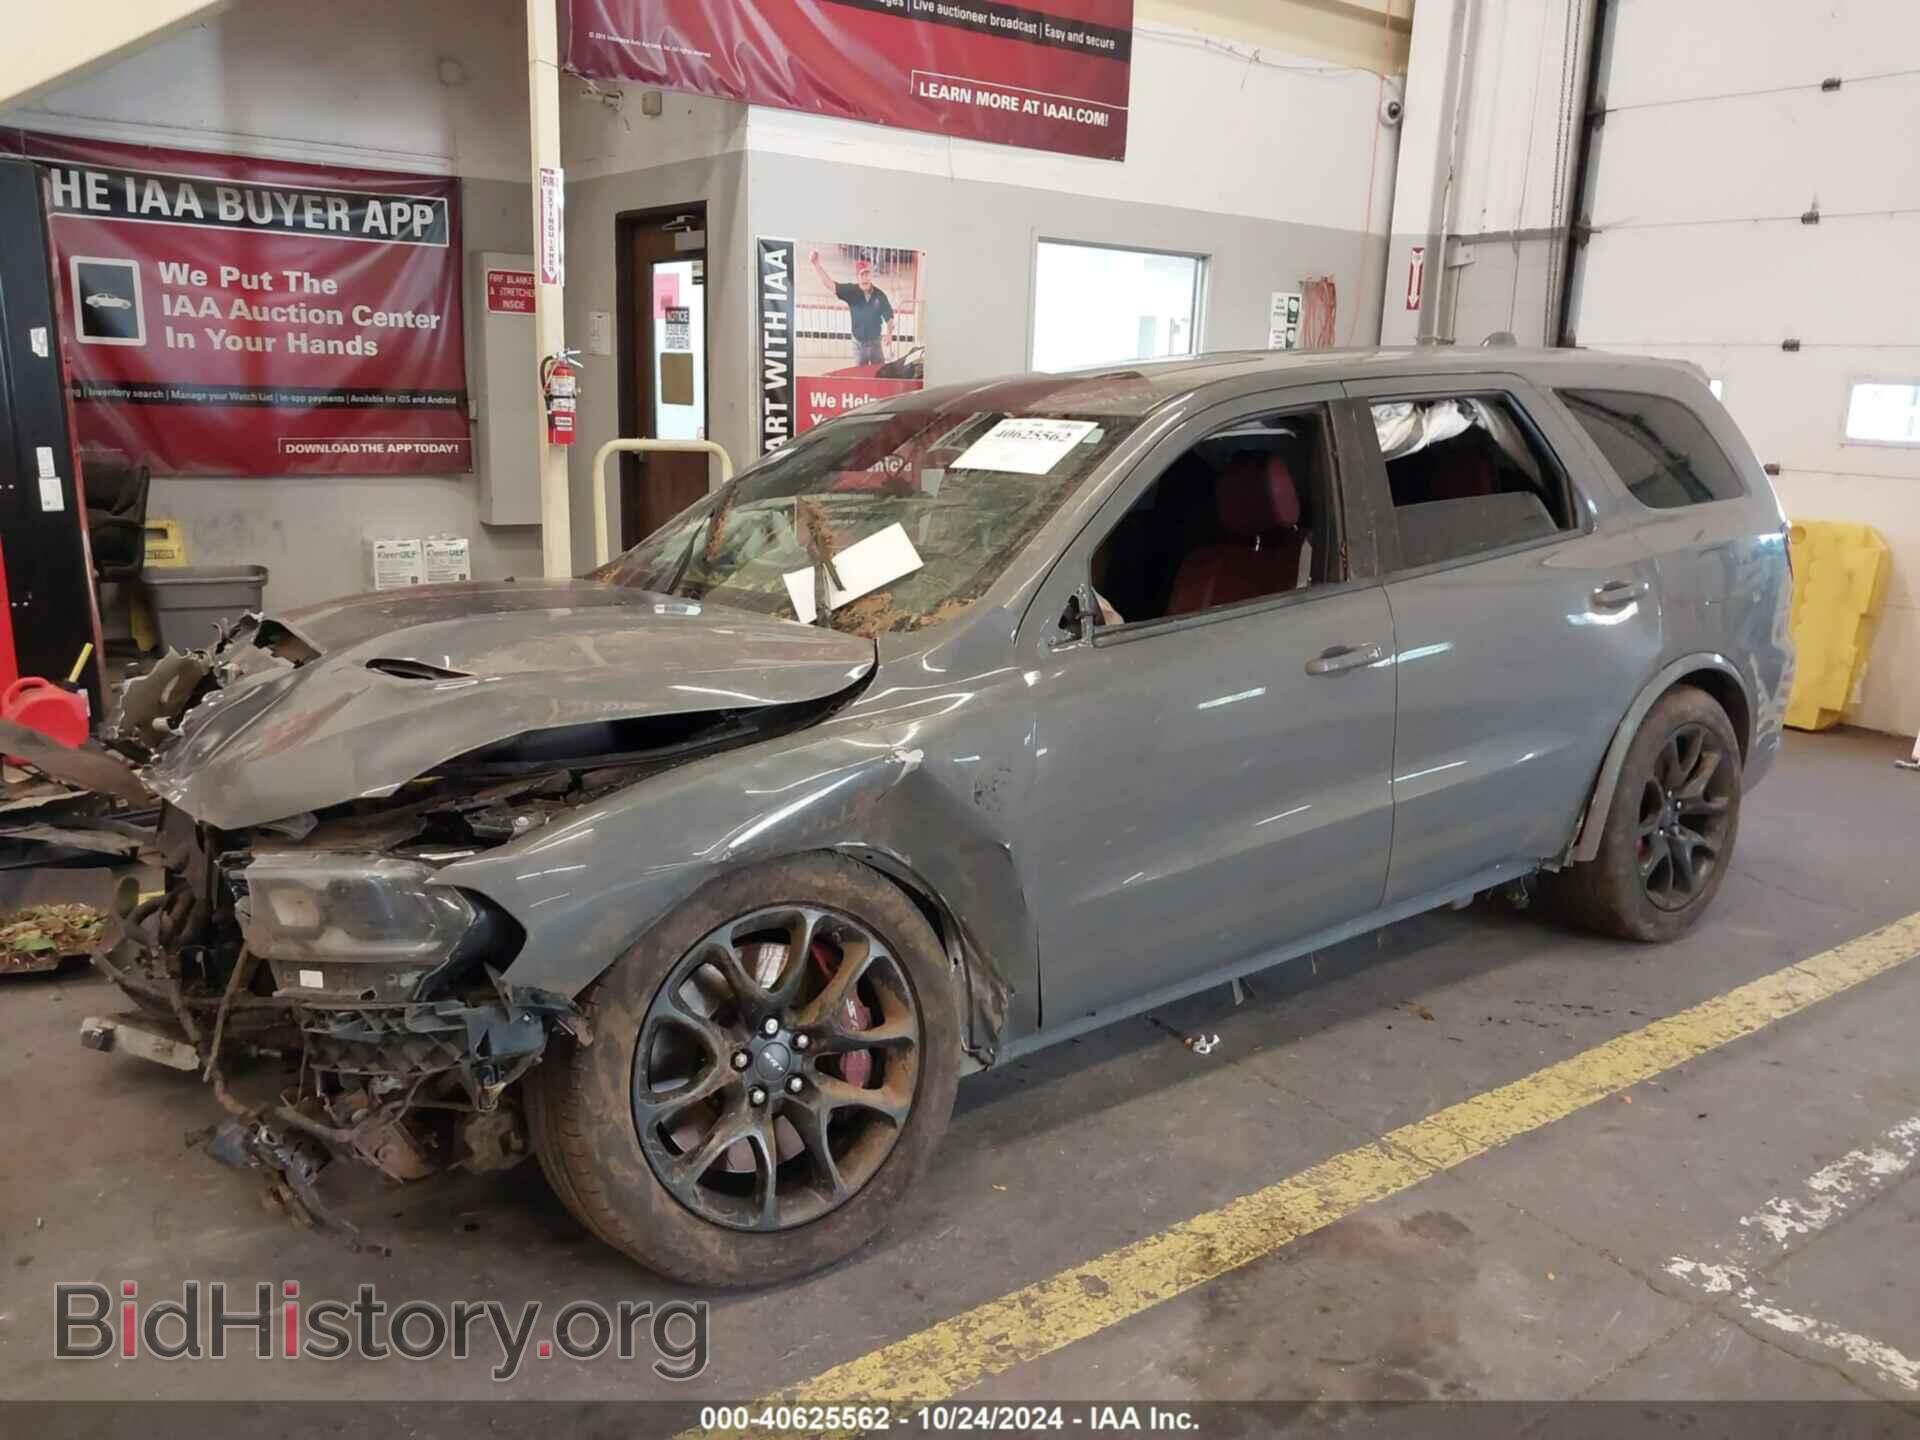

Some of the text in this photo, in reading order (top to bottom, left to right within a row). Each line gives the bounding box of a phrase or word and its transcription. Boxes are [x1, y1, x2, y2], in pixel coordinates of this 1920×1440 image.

[914, 0, 935, 12] Live
[937, 4, 987, 24] auctioneer
[990, 12, 1038, 34] broadcast
[1045, 23, 1065, 41] Easy
[1068, 27, 1084, 44] and
[1086, 34, 1115, 49] secure
[919, 81, 1109, 127] LEARN MORE AT IAAI.COM!
[51, 168, 434, 237] HE IAA BUYER APP
[158, 261, 338, 295] We Put The
[162, 294, 441, 329] IAA Auction Center
[667, 310, 688, 322] NOTICE
[165, 326, 378, 357] In Your Hands
[764, 249, 787, 450] ART WITH IAA
[88, 387, 131, 399] Inventory
[133, 388, 164, 399] search
[171, 389, 206, 401] Manage
[229, 391, 257, 401] Watch
[810, 391, 837, 408] We
[285, 443, 459, 454] DOWNLOAD THE APP TODAY!
